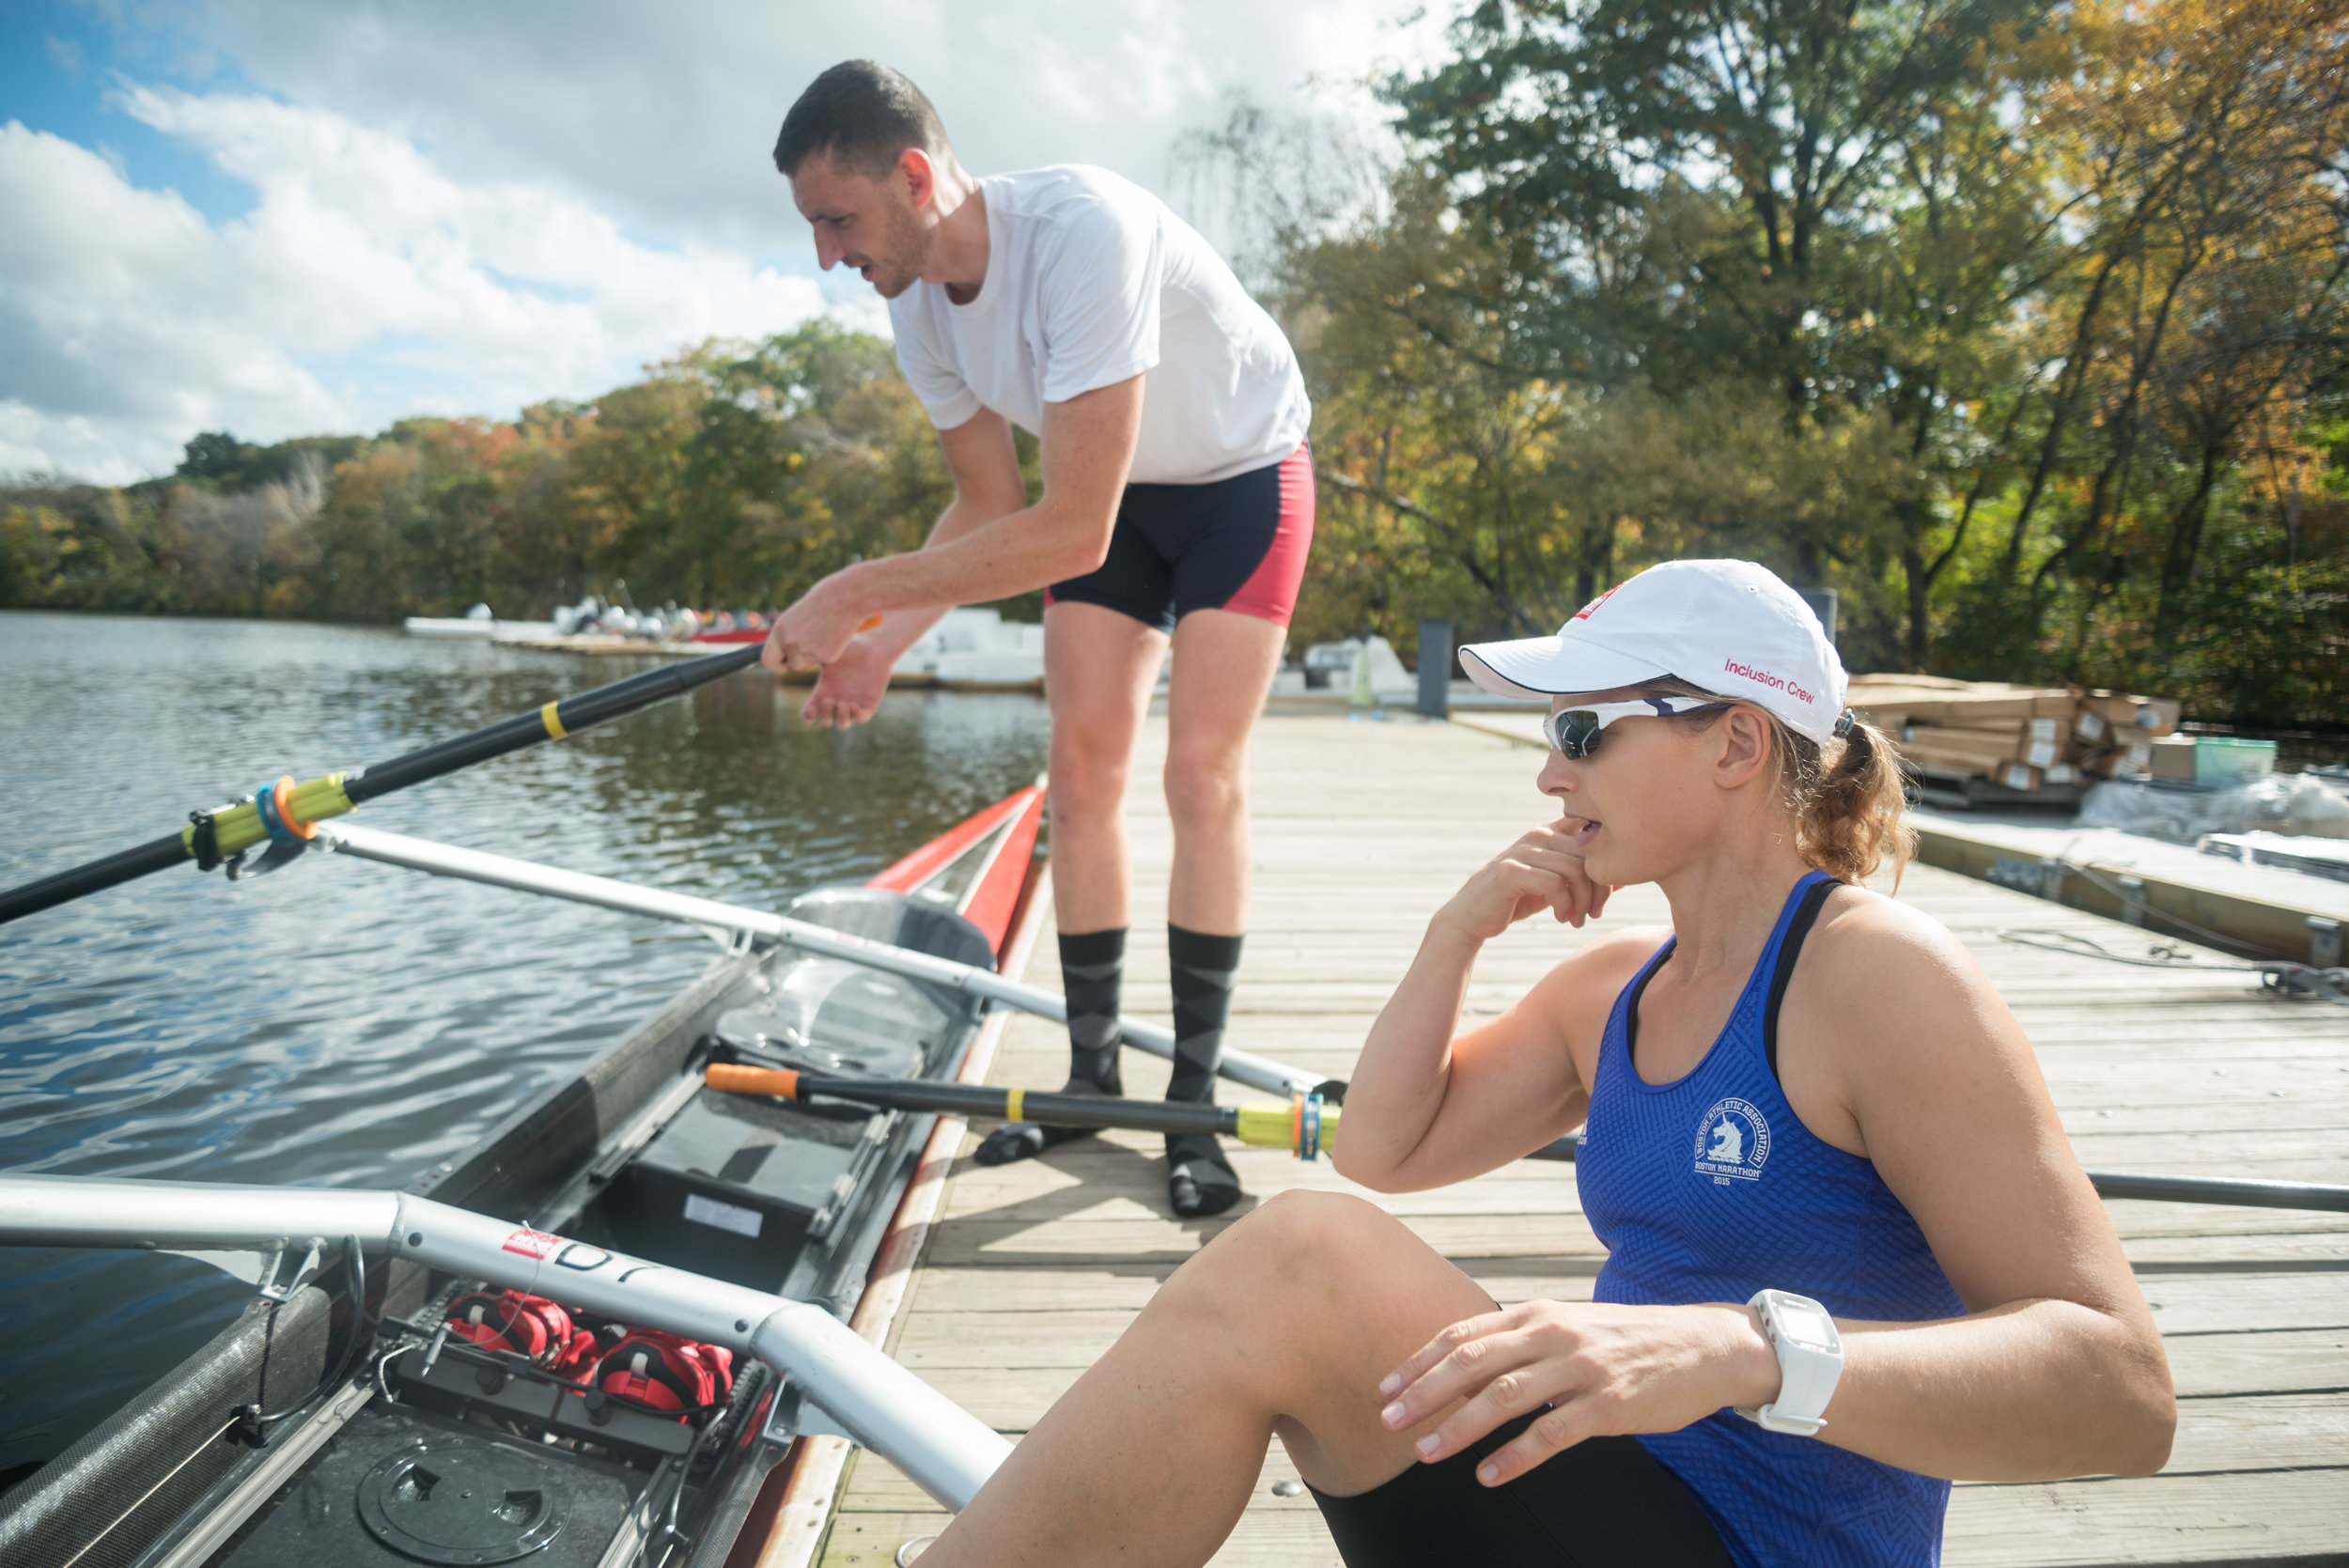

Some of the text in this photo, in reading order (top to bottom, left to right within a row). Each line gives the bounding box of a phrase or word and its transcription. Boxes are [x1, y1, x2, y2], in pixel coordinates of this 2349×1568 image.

[1724, 659, 1814, 705] Inclusion Crew
[1697, 1100, 1767, 1163] BOSTON ATHLETIC ASSOCIATION
[1694, 1161, 1716, 1172] BOSTON
[1713, 1176, 1731, 1186] 2015
